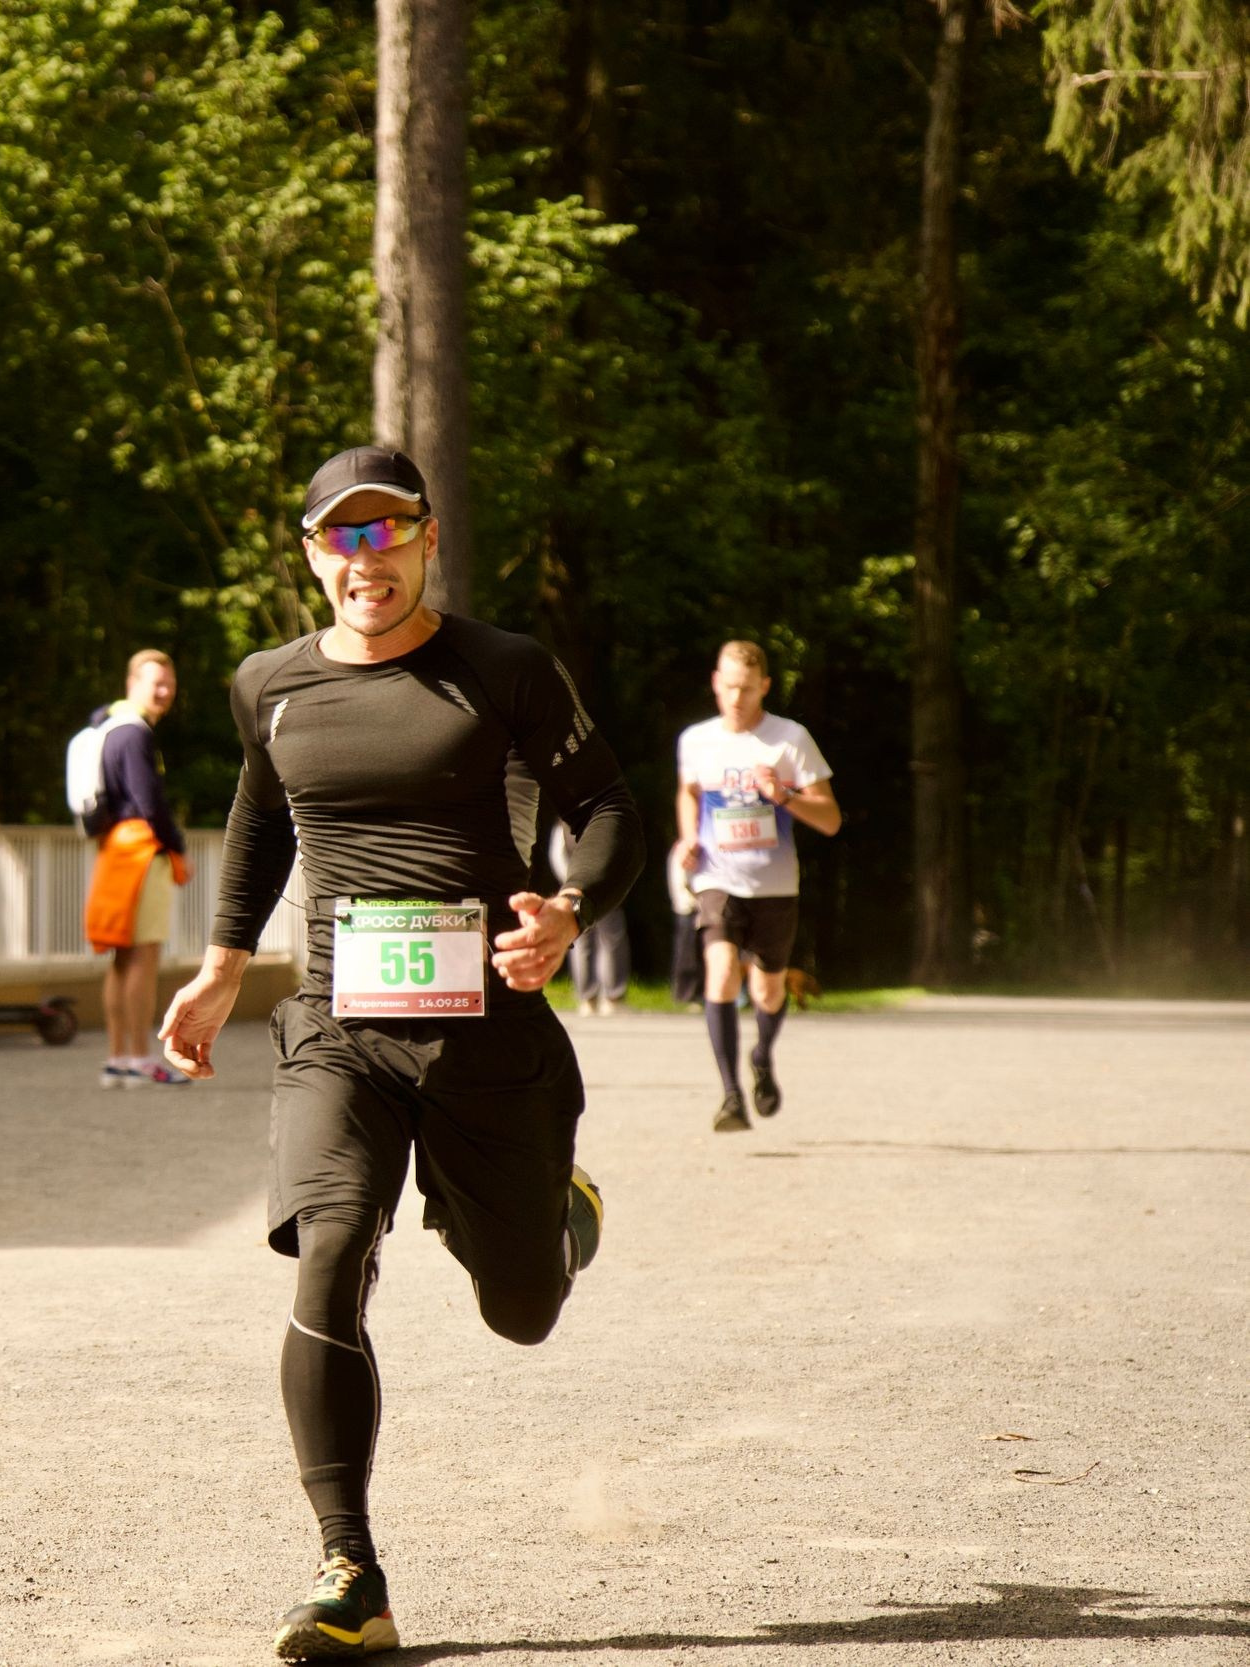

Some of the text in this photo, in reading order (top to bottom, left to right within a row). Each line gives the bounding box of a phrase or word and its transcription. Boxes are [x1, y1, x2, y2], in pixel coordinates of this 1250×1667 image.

[410, 914, 466, 930] ДУБКИ
[380, 941, 436, 986] 55
[418, 998, 470, 1008] 14.09.25
